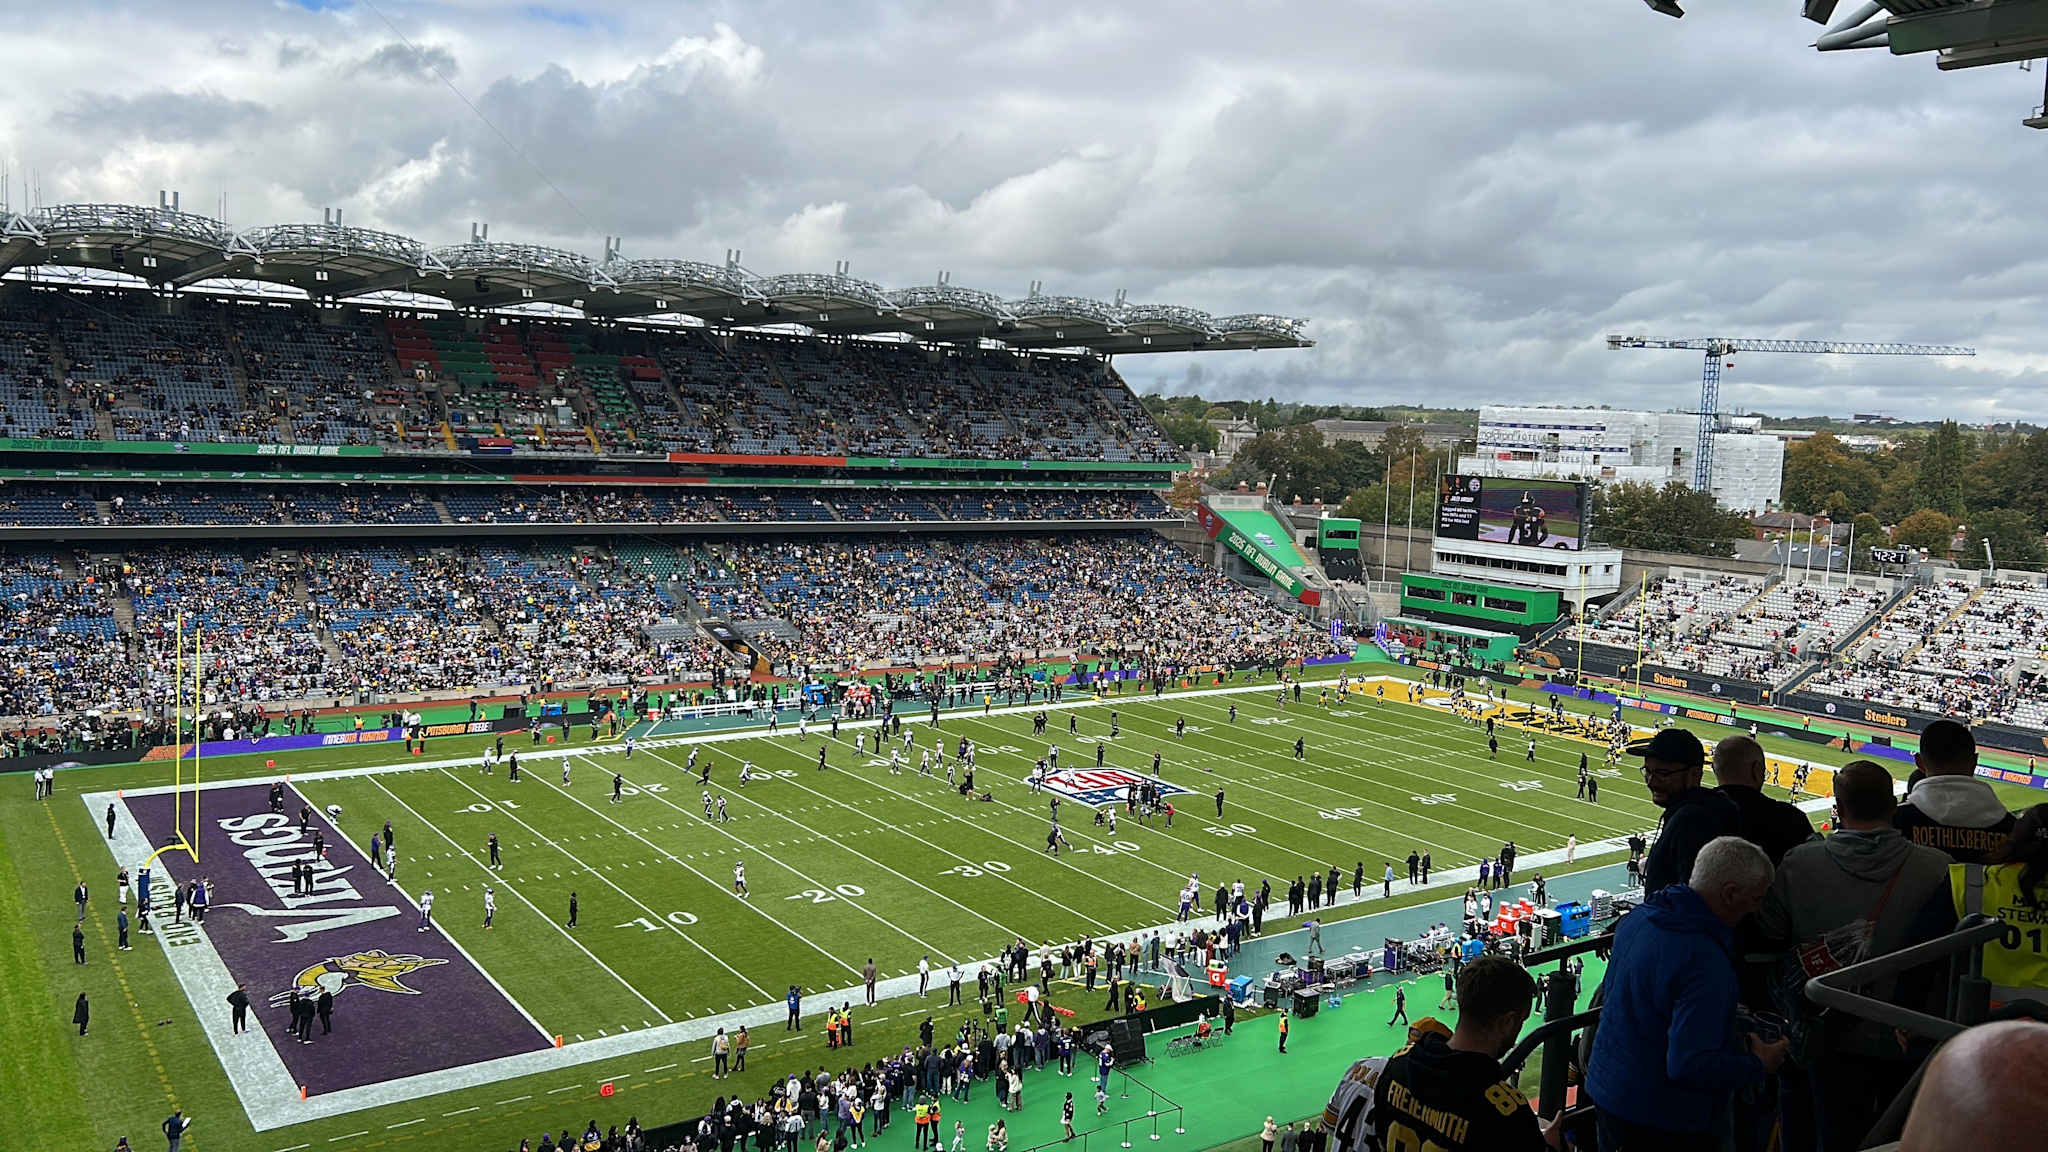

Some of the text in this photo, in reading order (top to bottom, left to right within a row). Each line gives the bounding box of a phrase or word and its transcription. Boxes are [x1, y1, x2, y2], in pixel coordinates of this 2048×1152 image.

[256, 445, 340, 456] 2025 NFL DUBLIN GAME
[1229, 532, 1296, 590] 2025 NFL DUBLIN GAME
[1874, 552, 1904, 563] 42:21
[1653, 672, 1688, 688] Steelers
[1865, 708, 1908, 727] Steelers
[426, 724, 466, 737] PITTSBURGH
[1045, 771, 1144, 791] NFL
[467, 799, 521, 813] 10
[1203, 823, 1257, 837] 50
[1092, 840, 1141, 855] 40
[953, 860, 1012, 877] 30
[205, 812, 402, 944] VIKINGS
[802, 884, 866, 903] 20
[631, 911, 699, 932] 10
[160, 921, 201, 947] END
[1211, 972, 1220, 982] G
